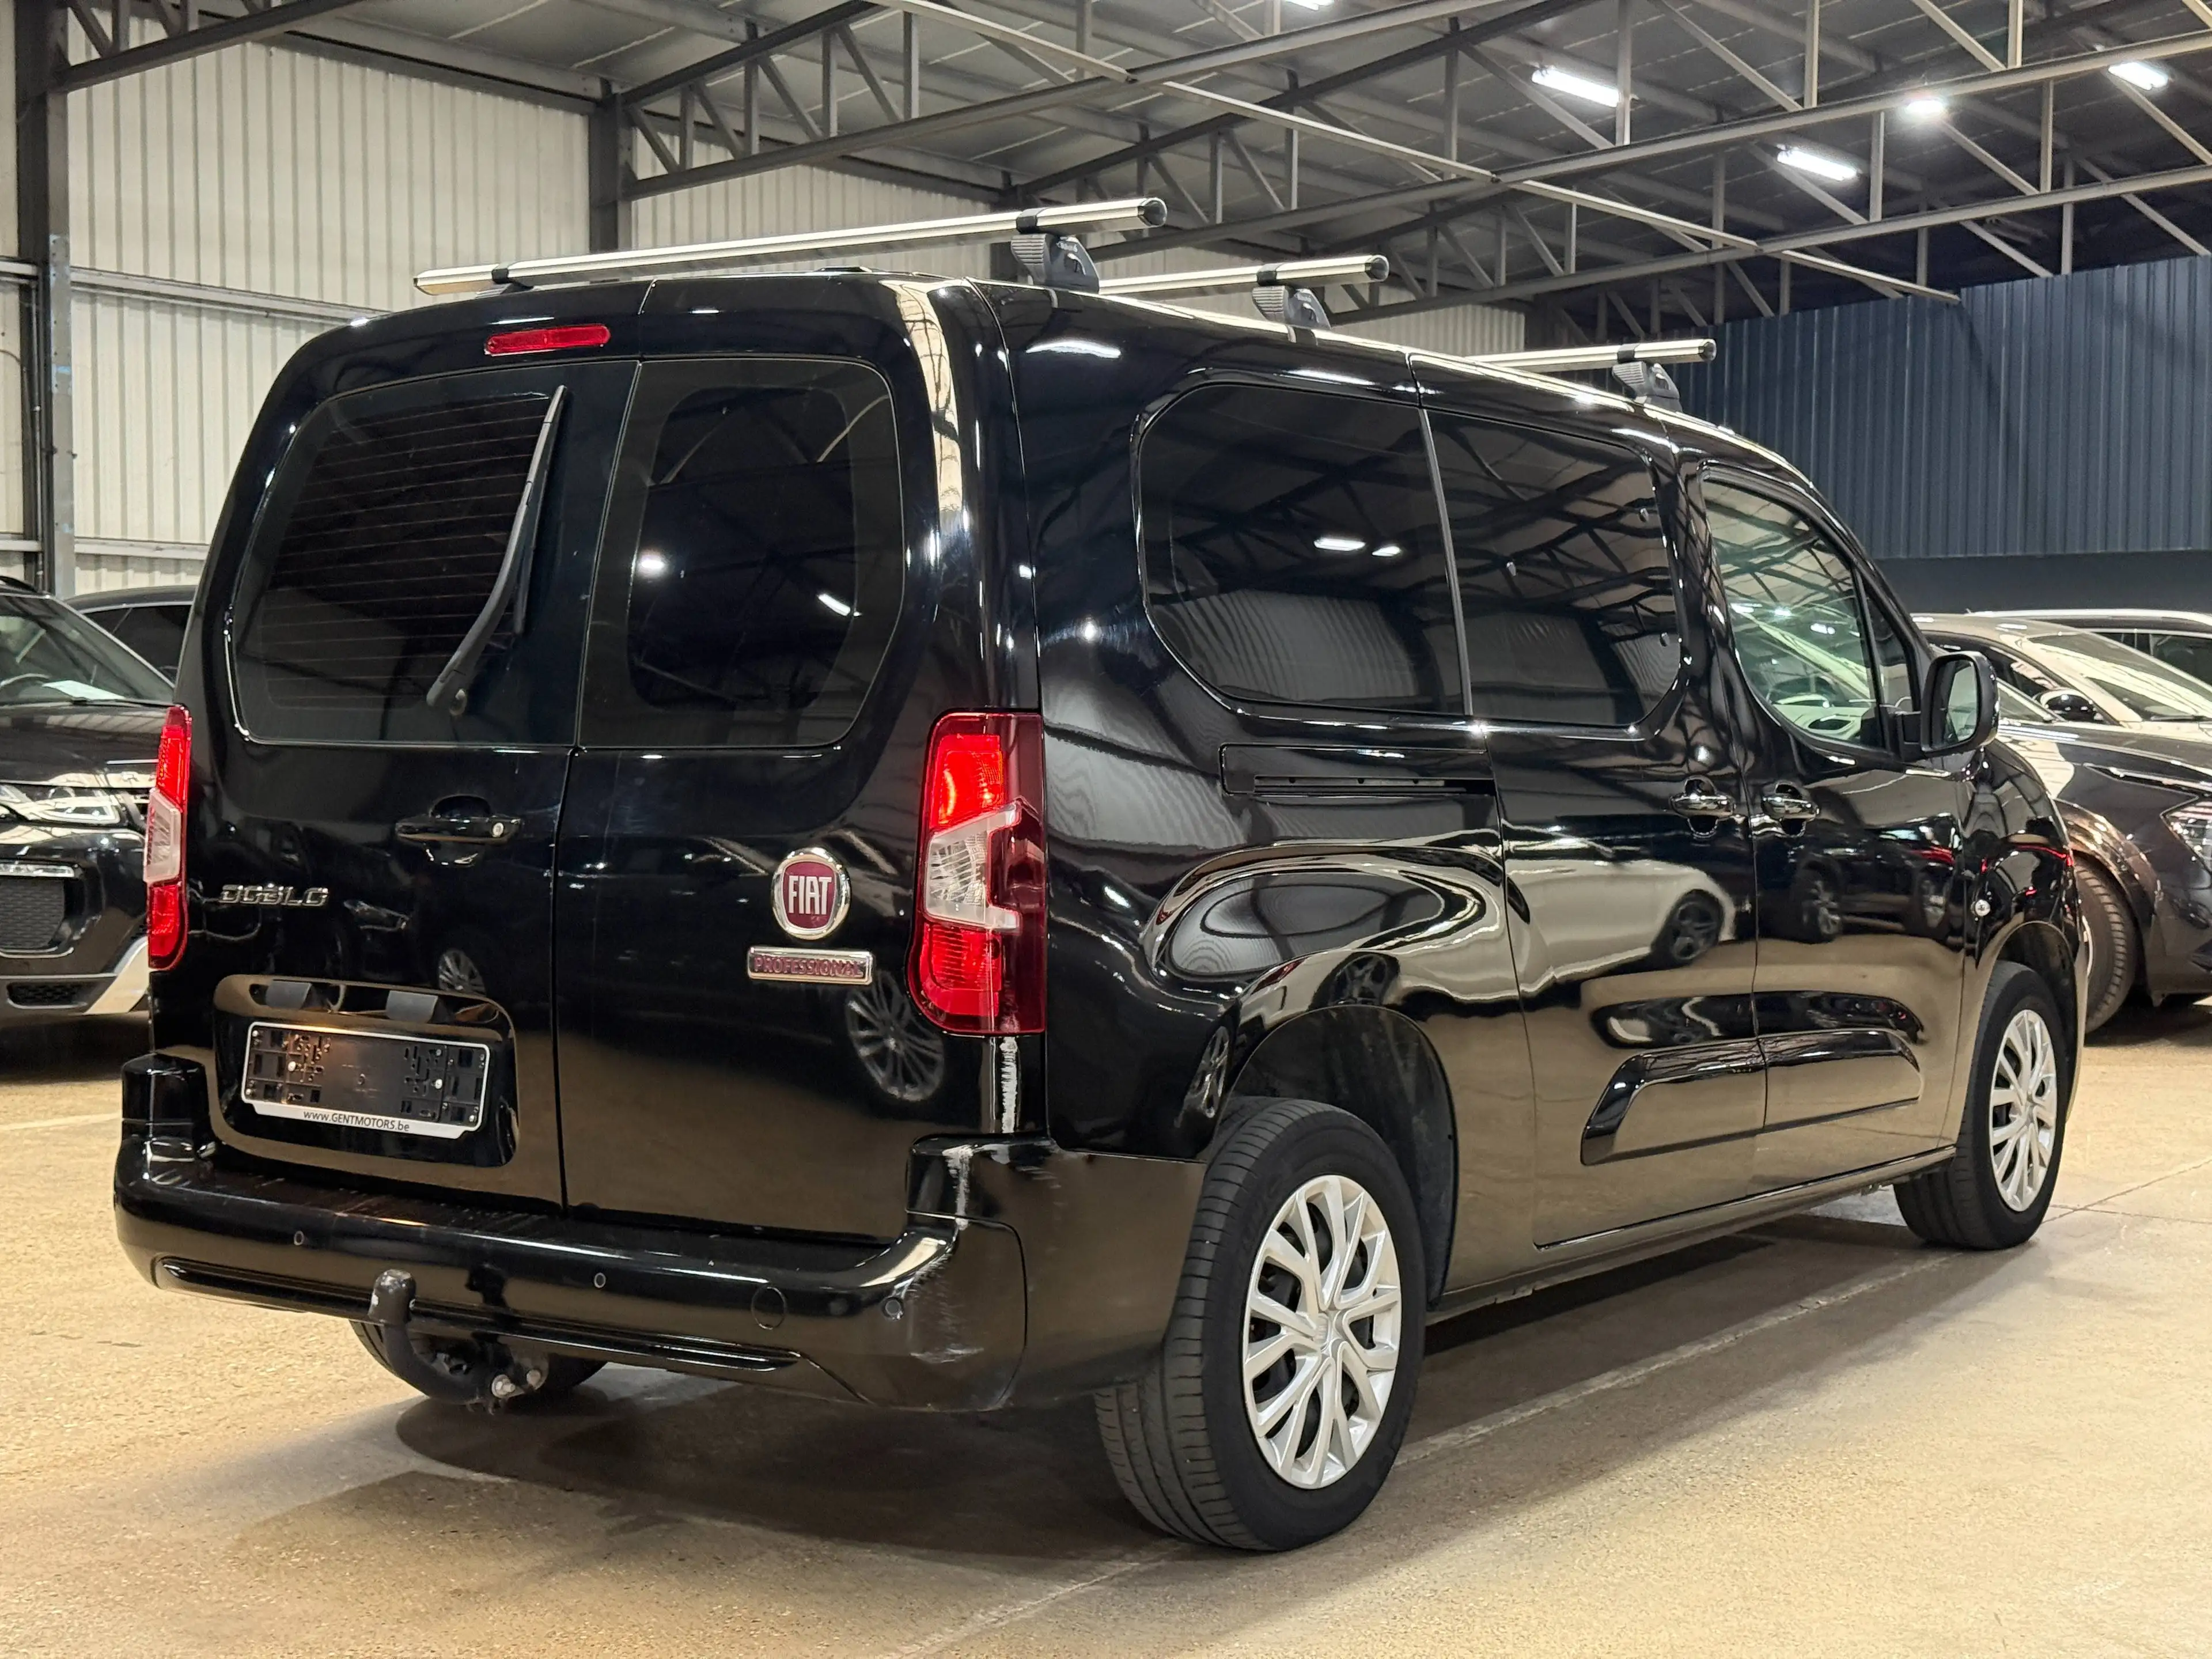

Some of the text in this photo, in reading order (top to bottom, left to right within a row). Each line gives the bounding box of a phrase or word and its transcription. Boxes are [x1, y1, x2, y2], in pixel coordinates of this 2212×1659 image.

[788, 875, 832, 915] FIAT
[754, 955, 864, 978] PROFESSIONAL
[303, 1111, 410, 1132] www.GENTMOTORS.be
